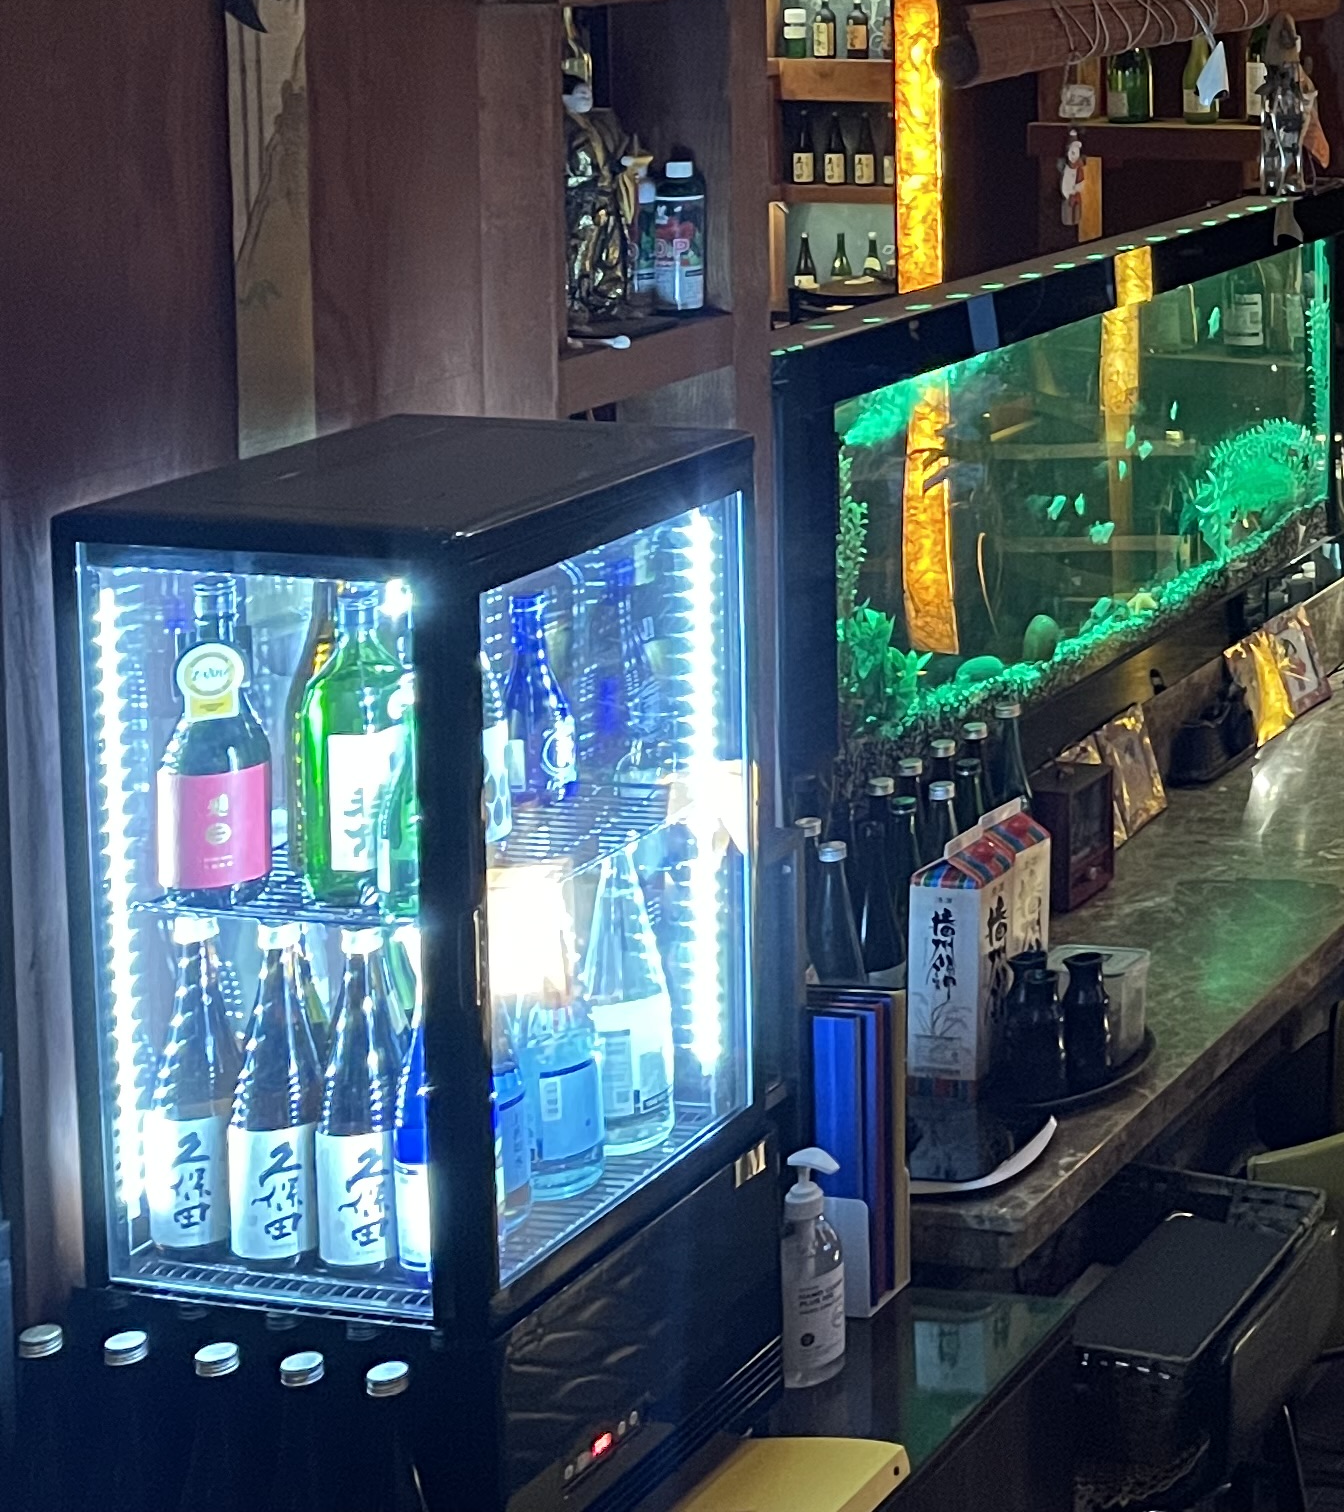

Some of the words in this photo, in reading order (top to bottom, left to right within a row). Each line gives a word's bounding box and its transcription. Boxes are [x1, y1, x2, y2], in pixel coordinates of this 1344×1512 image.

[171, 1132, 211, 1229] 久保田
[251, 1141, 303, 1241] 久保田
[338, 1148, 390, 1248] 久保田
